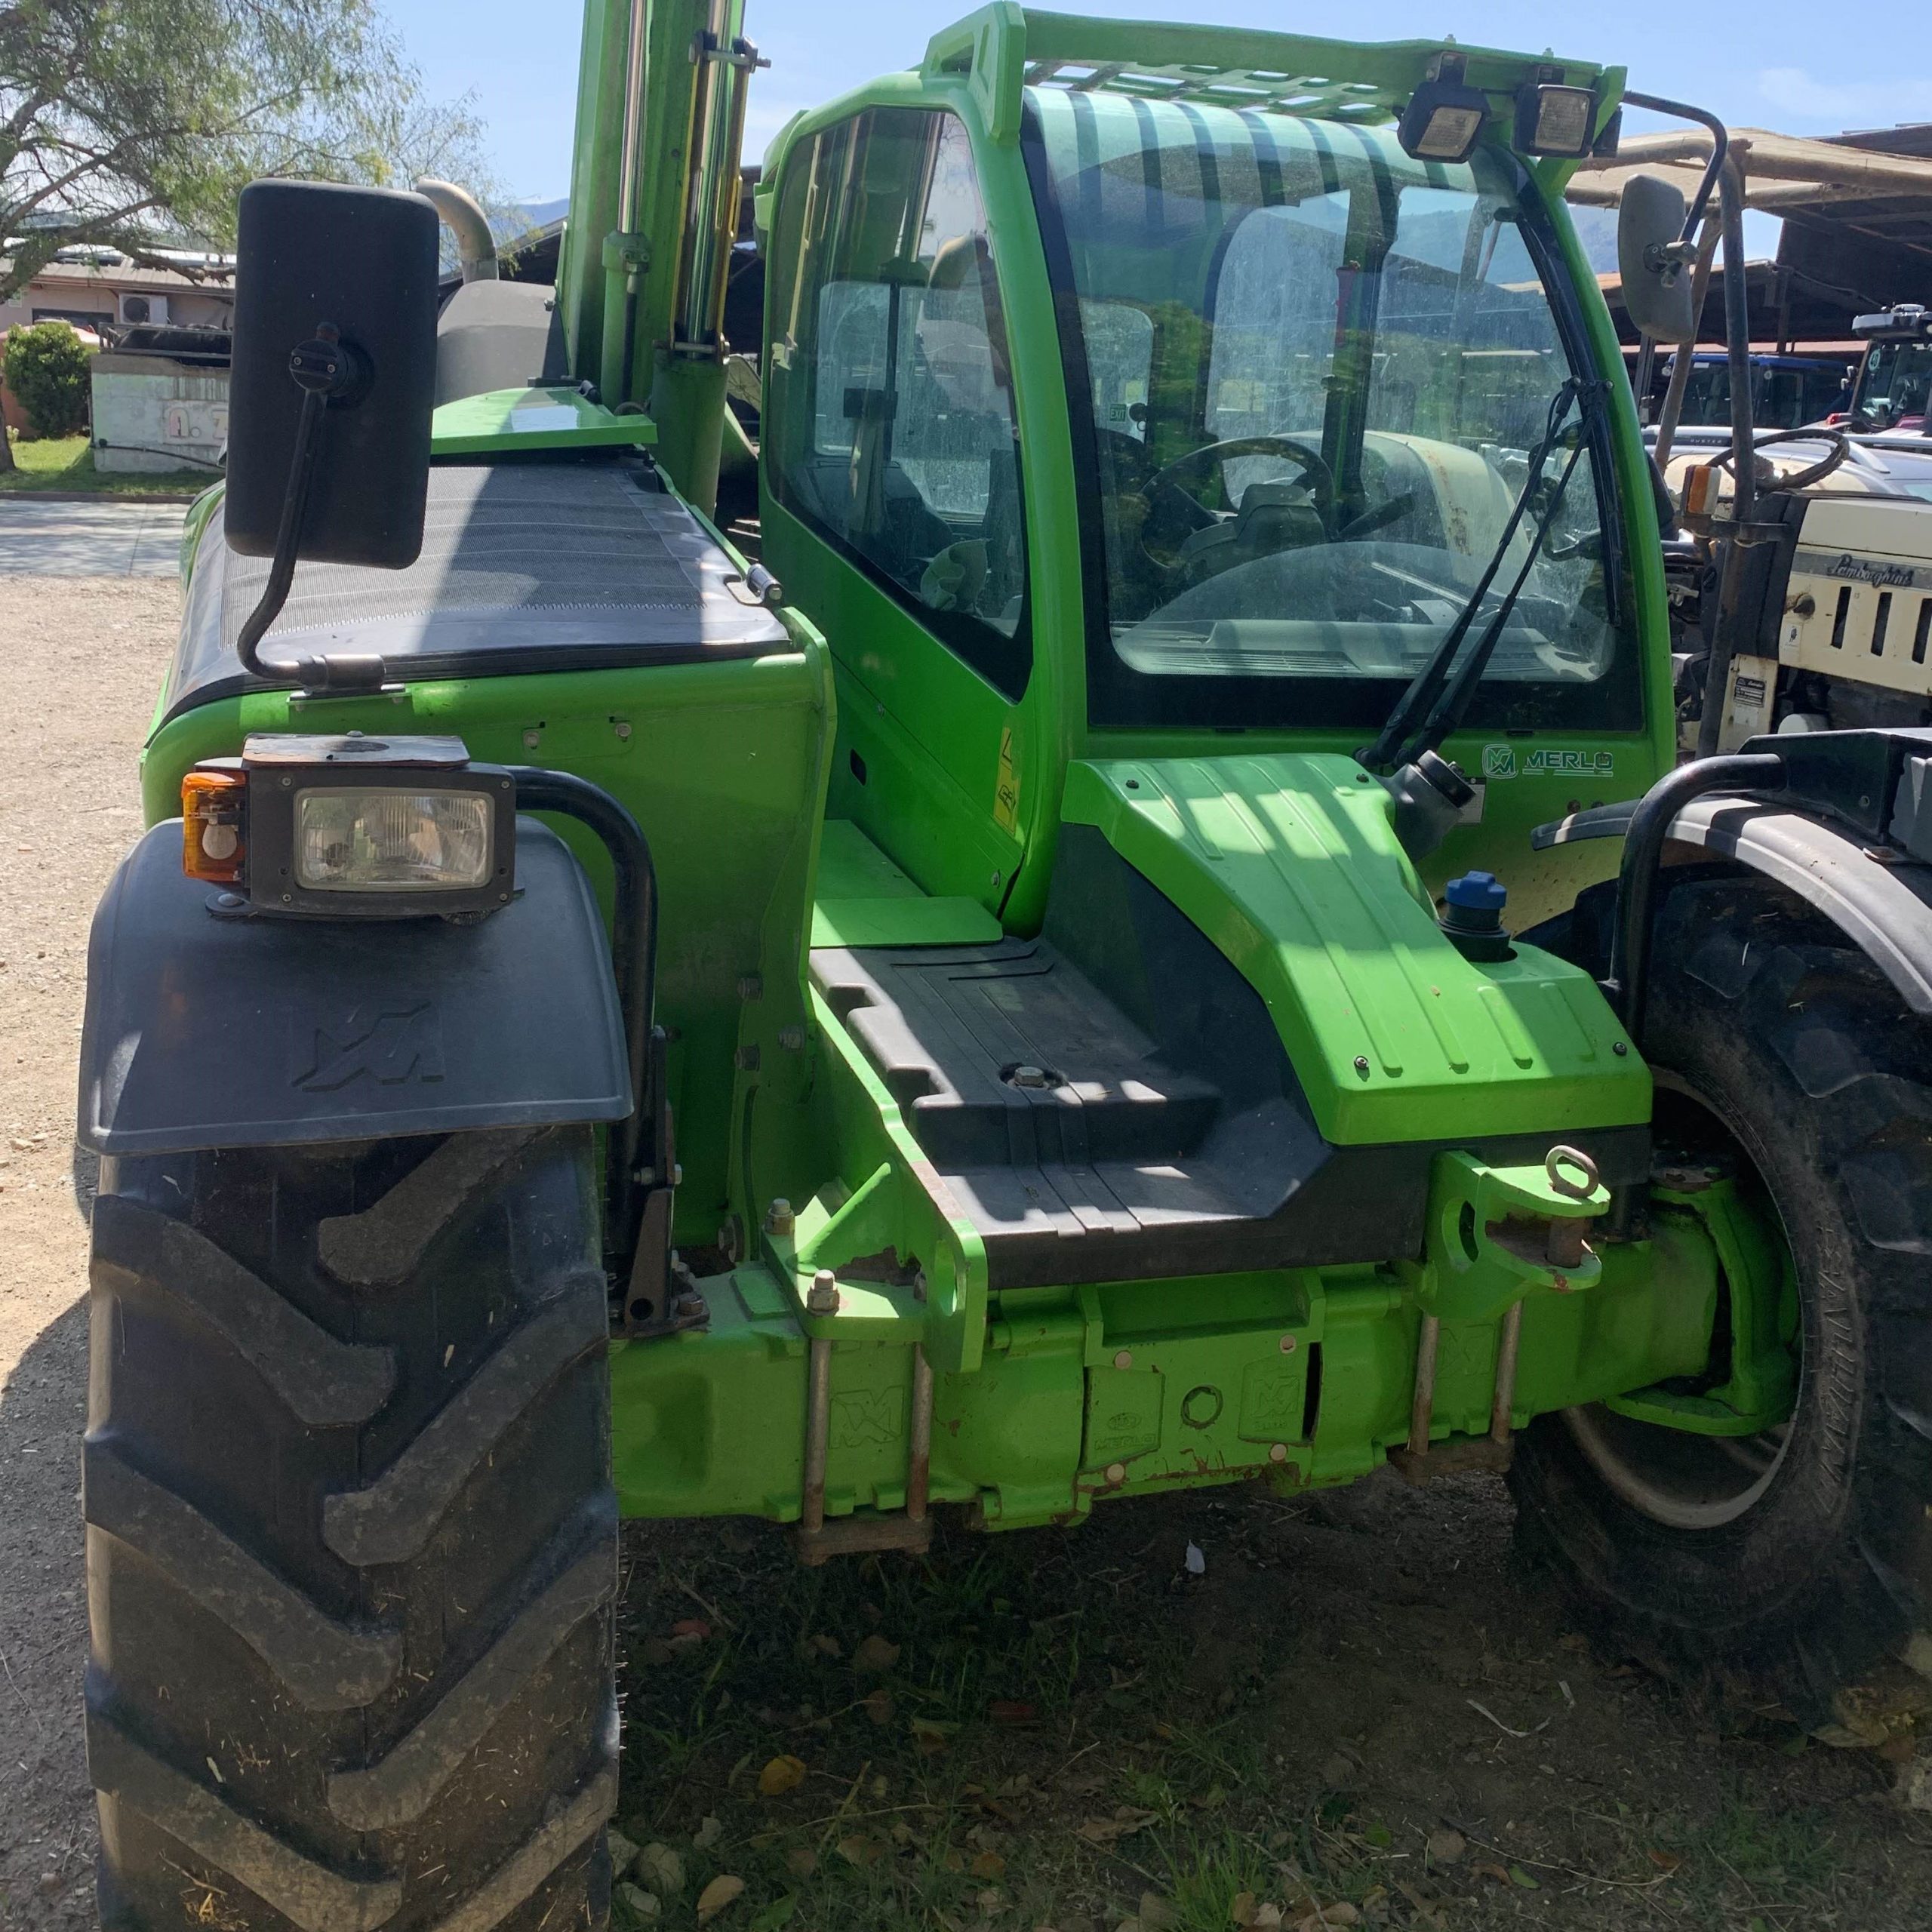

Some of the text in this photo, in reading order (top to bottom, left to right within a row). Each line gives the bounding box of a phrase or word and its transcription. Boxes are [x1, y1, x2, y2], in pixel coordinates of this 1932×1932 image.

[1110, 408, 1126, 420] EXIT
[1827, 553, 1915, 589] Lamborghini
[1524, 750, 1614, 771] MERLO
